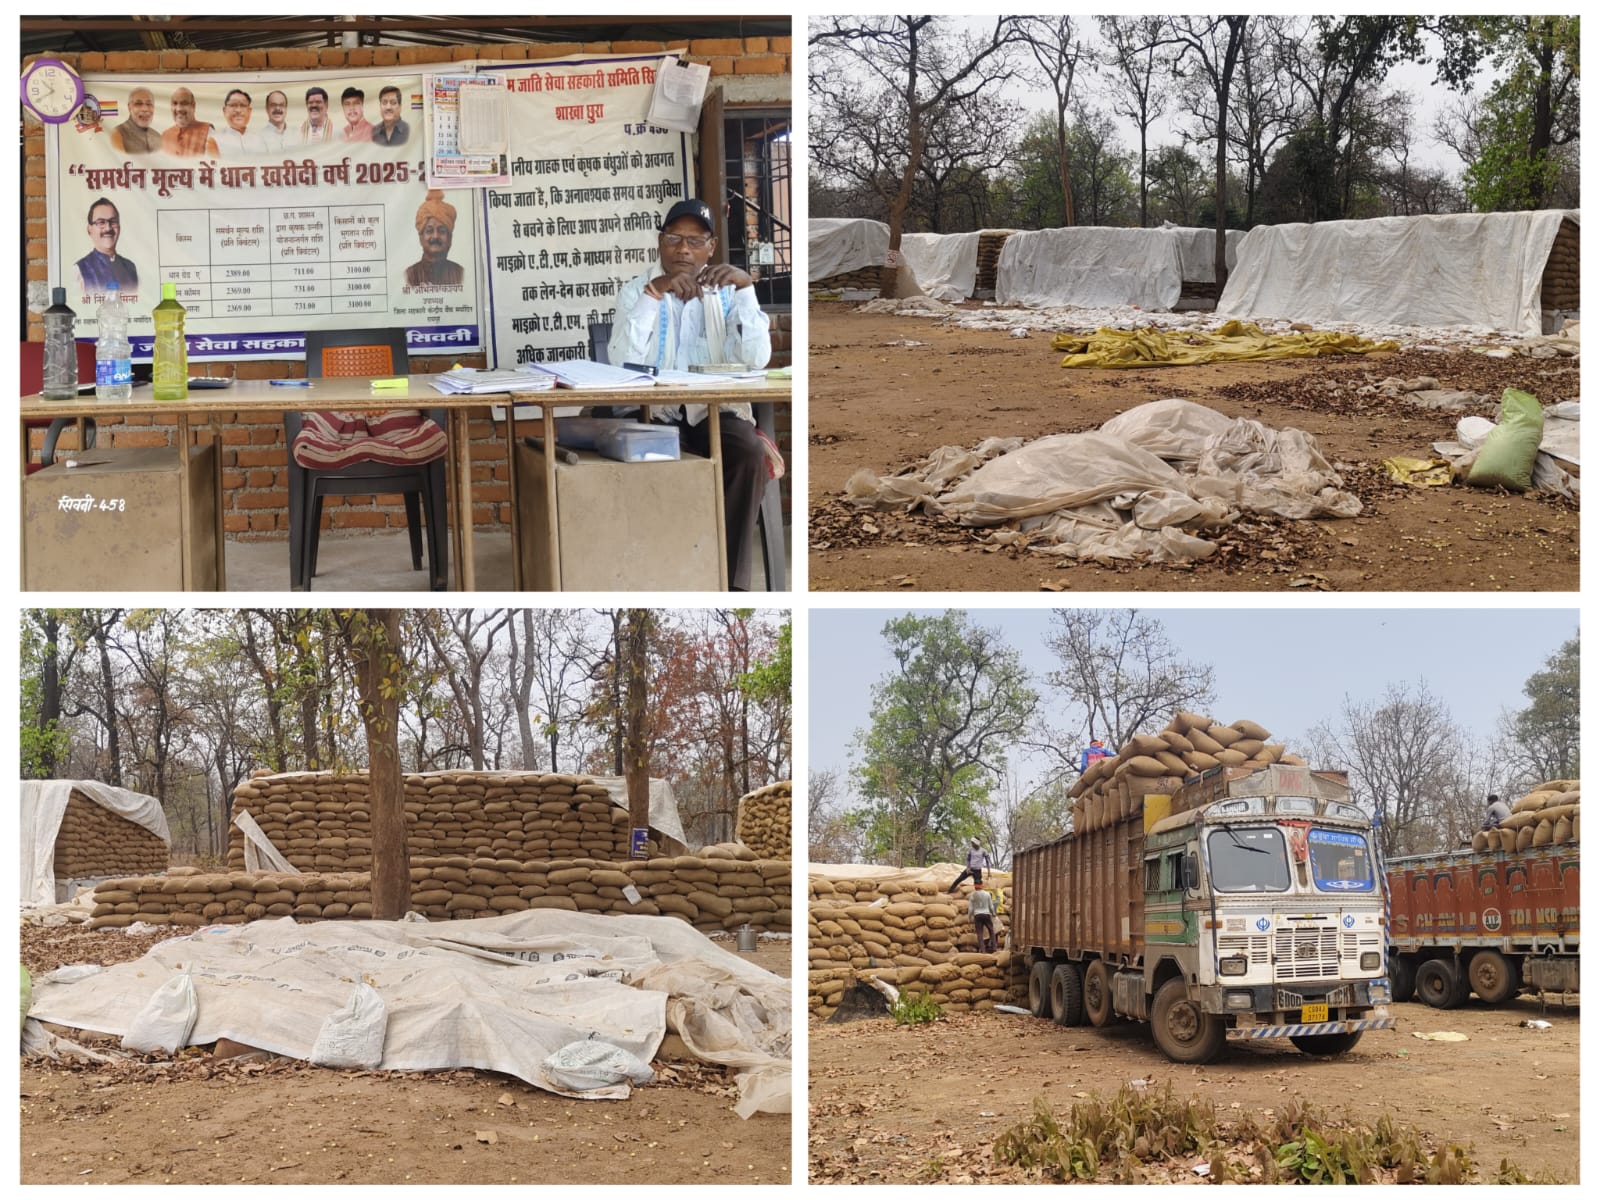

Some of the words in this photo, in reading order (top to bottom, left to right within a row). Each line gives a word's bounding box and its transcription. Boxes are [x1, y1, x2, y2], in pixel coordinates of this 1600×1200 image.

[518, 73, 542, 92] जाति
[545, 72, 564, 91] सेवा
[567, 69, 605, 89] सहकारी
[608, 67, 640, 87] समिति
[556, 104, 584, 121] शाखा
[586, 103, 604, 124] छुरा
[535, 160, 560, 175] ग्राहक
[562, 154, 575, 173] एवं
[577, 158, 601, 177] कृषक
[603, 150, 629, 176] बंधुओं
[630, 151, 643, 172] को
[644, 152, 675, 169] अवगत
[151, 167, 194, 197] मूल्य
[199, 160, 216, 188] में
[220, 166, 256, 188] धान
[261, 159, 318, 187] खरीदी
[322, 157, 351, 185] वर्ष
[355, 161, 425, 185] 2025-2
[489, 189, 512, 209] किया
[513, 192, 536, 208] जाता
[550, 185, 564, 205] कि
[565, 186, 611, 204] अनावश्यक
[613, 185, 635, 200] समय
[637, 186, 644, 199] व
[645, 179, 682, 203] असुविधा
[513, 219, 521, 238] से
[523, 218, 544, 238] बचने
[546, 217, 555, 236] के
[557, 216, 576, 235] लिए
[578, 217, 597, 235] आप
[599, 213, 622, 232] अपने
[623, 211, 653, 231] समिति
[496, 250, 526, 273] माइक्रो
[583, 250, 612, 268] माध्यम
[614, 245, 623, 265] से
[624, 247, 646, 263] नगद
[522, 286, 538, 302] तक
[576, 284, 590, 299] कर
[592, 277, 615, 298] सकते
[512, 312, 541, 335] माइक्रो
[196, 337, 238, 351] सेवा
[242, 337, 306, 351] सहका
[405, 328, 472, 343] सिवनी
[517, 344, 545, 365] अधिक
[546, 341, 585, 363] जानकारी
[1278, 990, 1302, 1009] GOOD
